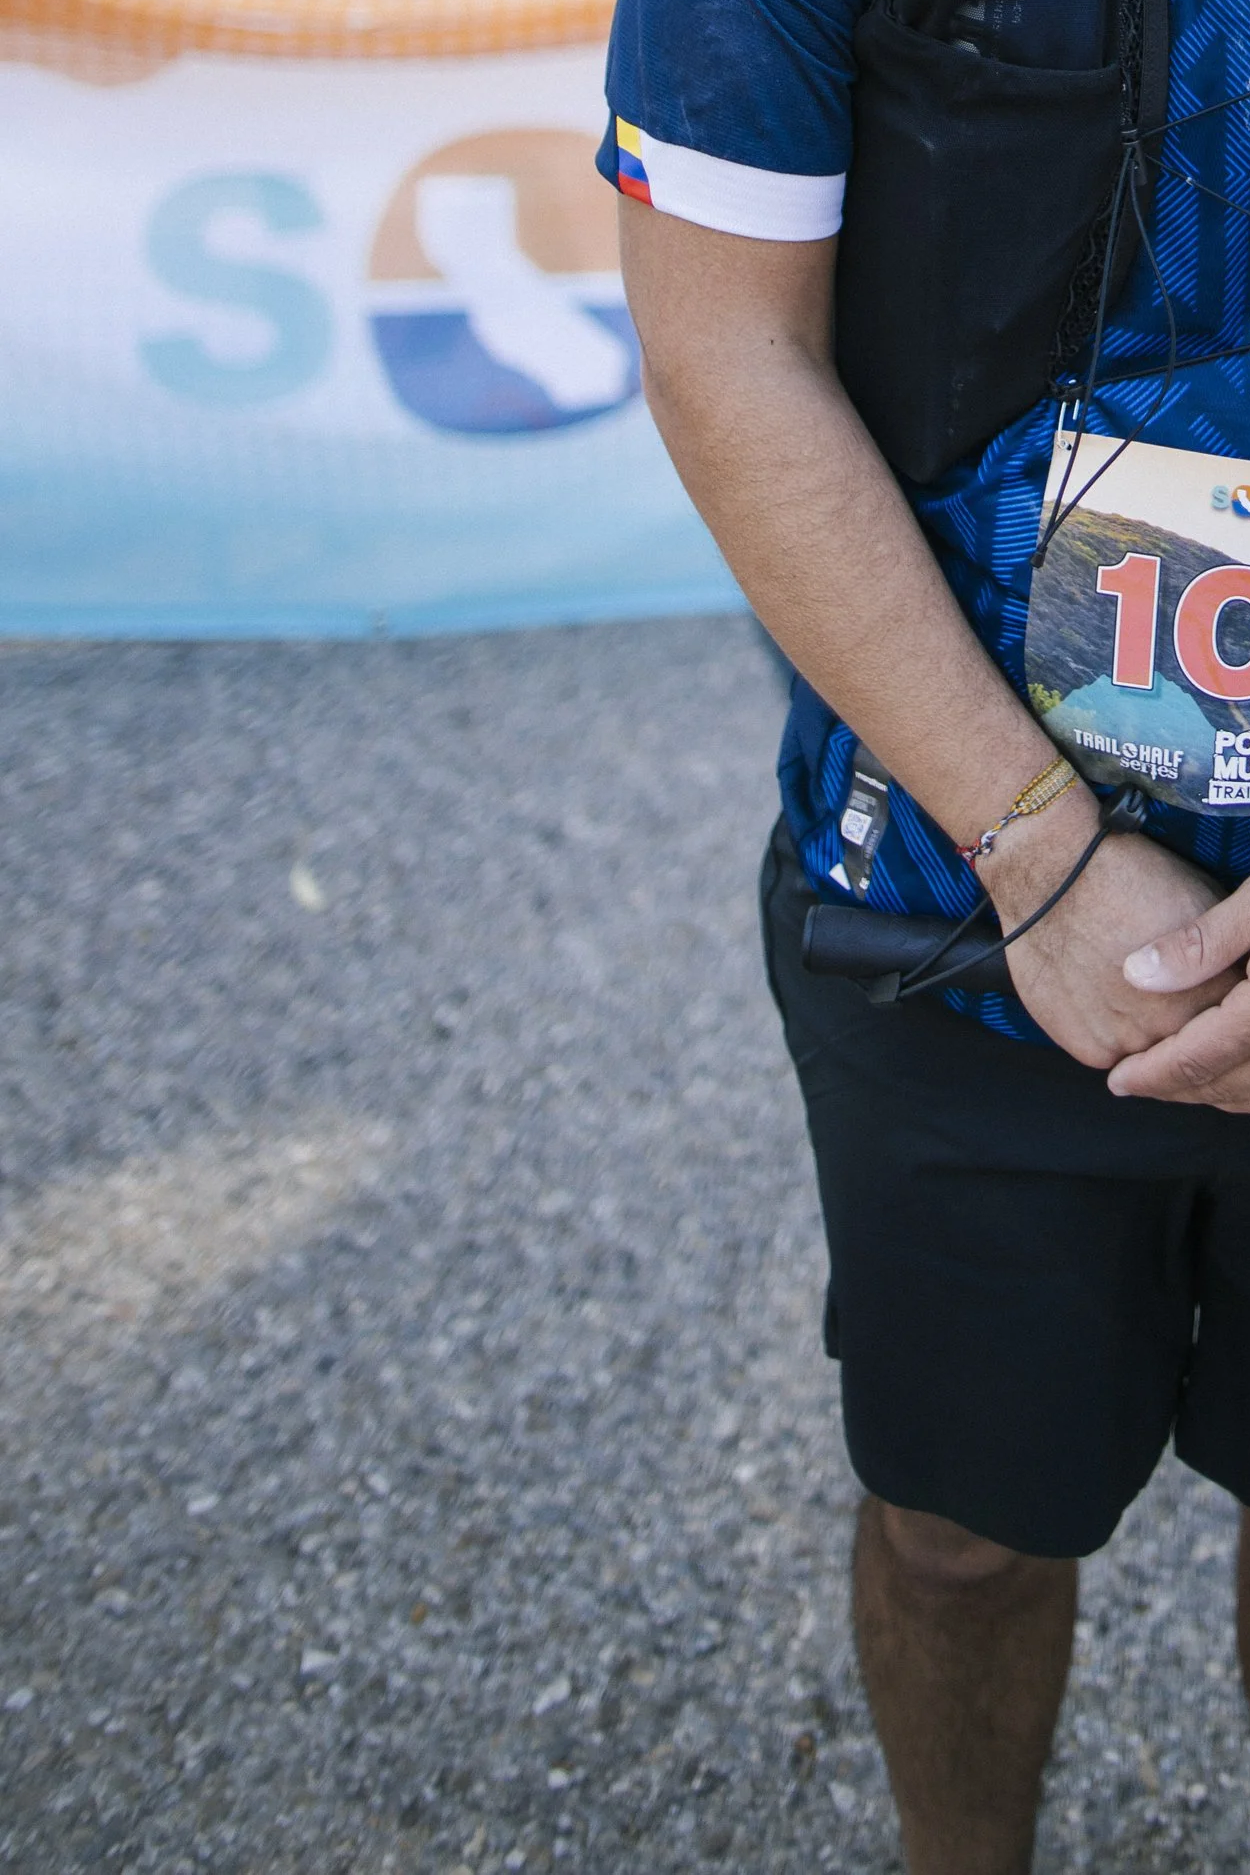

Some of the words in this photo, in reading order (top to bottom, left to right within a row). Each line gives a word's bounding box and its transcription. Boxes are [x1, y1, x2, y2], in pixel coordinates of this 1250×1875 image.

[1073, 728, 1121, 756] TRAIL
[1139, 744, 1184, 768] HALF
[1119, 757, 1179, 781] series
